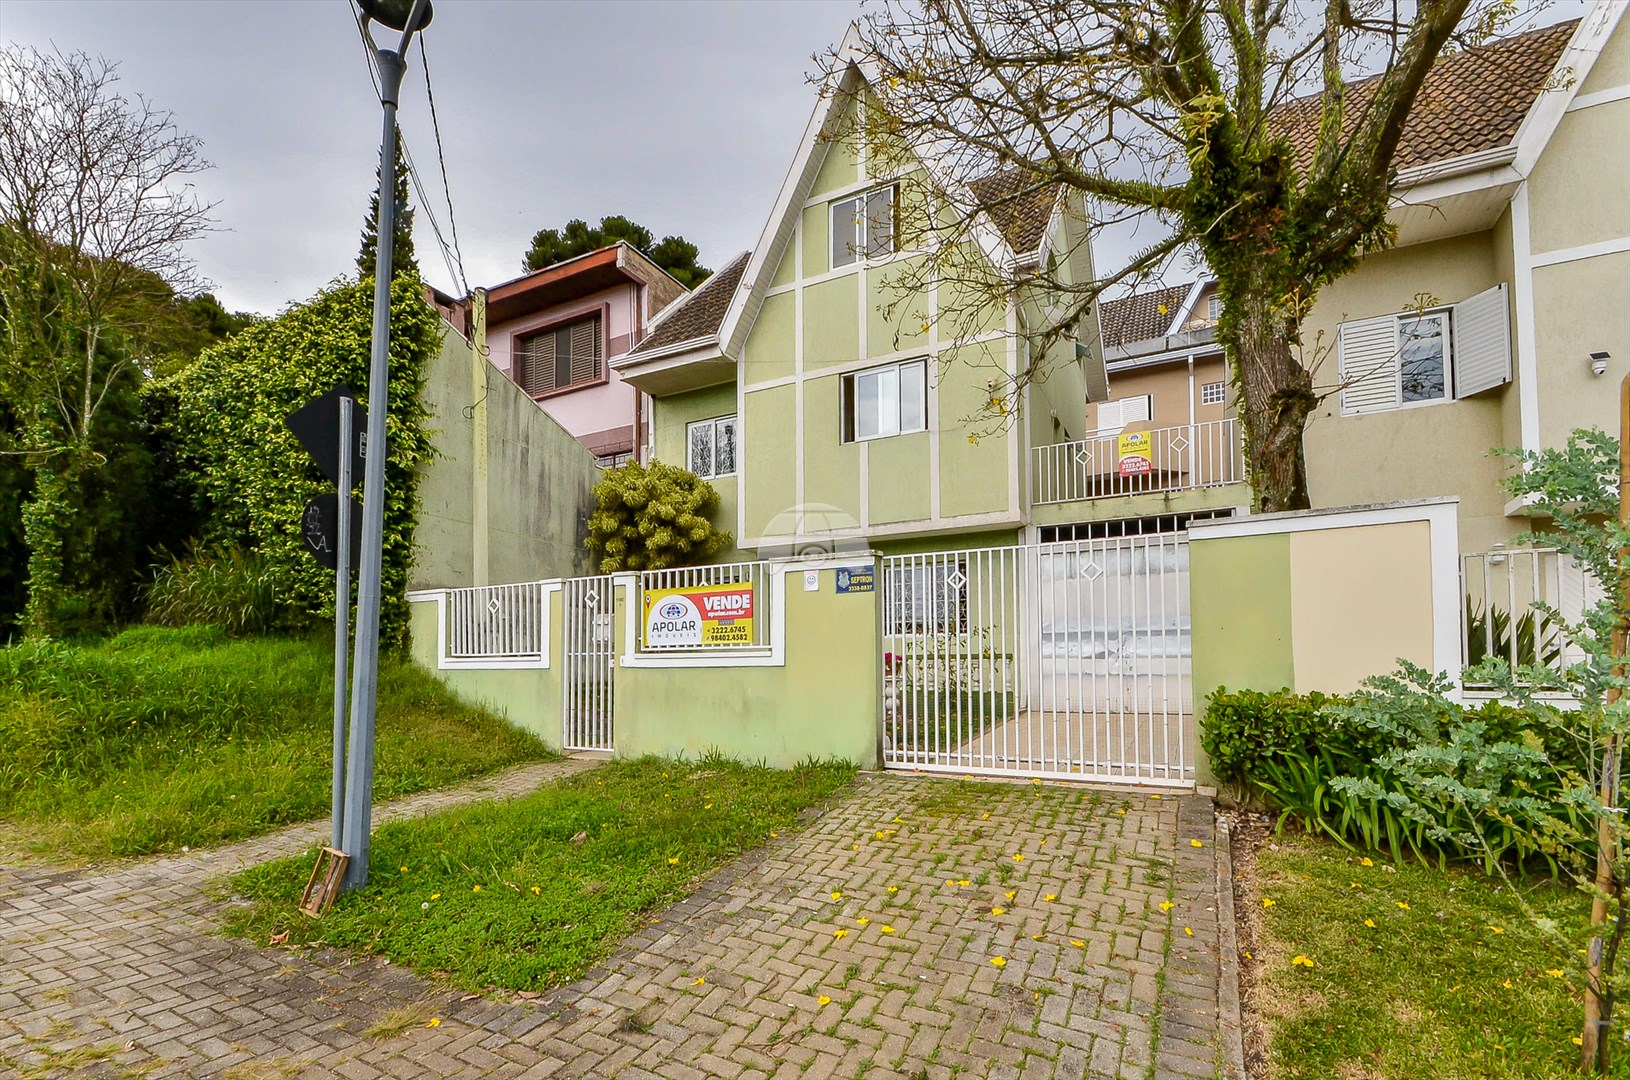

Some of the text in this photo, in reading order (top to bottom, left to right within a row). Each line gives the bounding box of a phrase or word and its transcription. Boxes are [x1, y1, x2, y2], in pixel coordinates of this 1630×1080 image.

[1122, 440, 1148, 448] APOLAR
[703, 594, 750, 610] VENDE
[708, 610, 744, 618] apolar.com.br
[652, 620, 696, 632] APOLAR
[711, 626, 746, 634] 3222.6745
